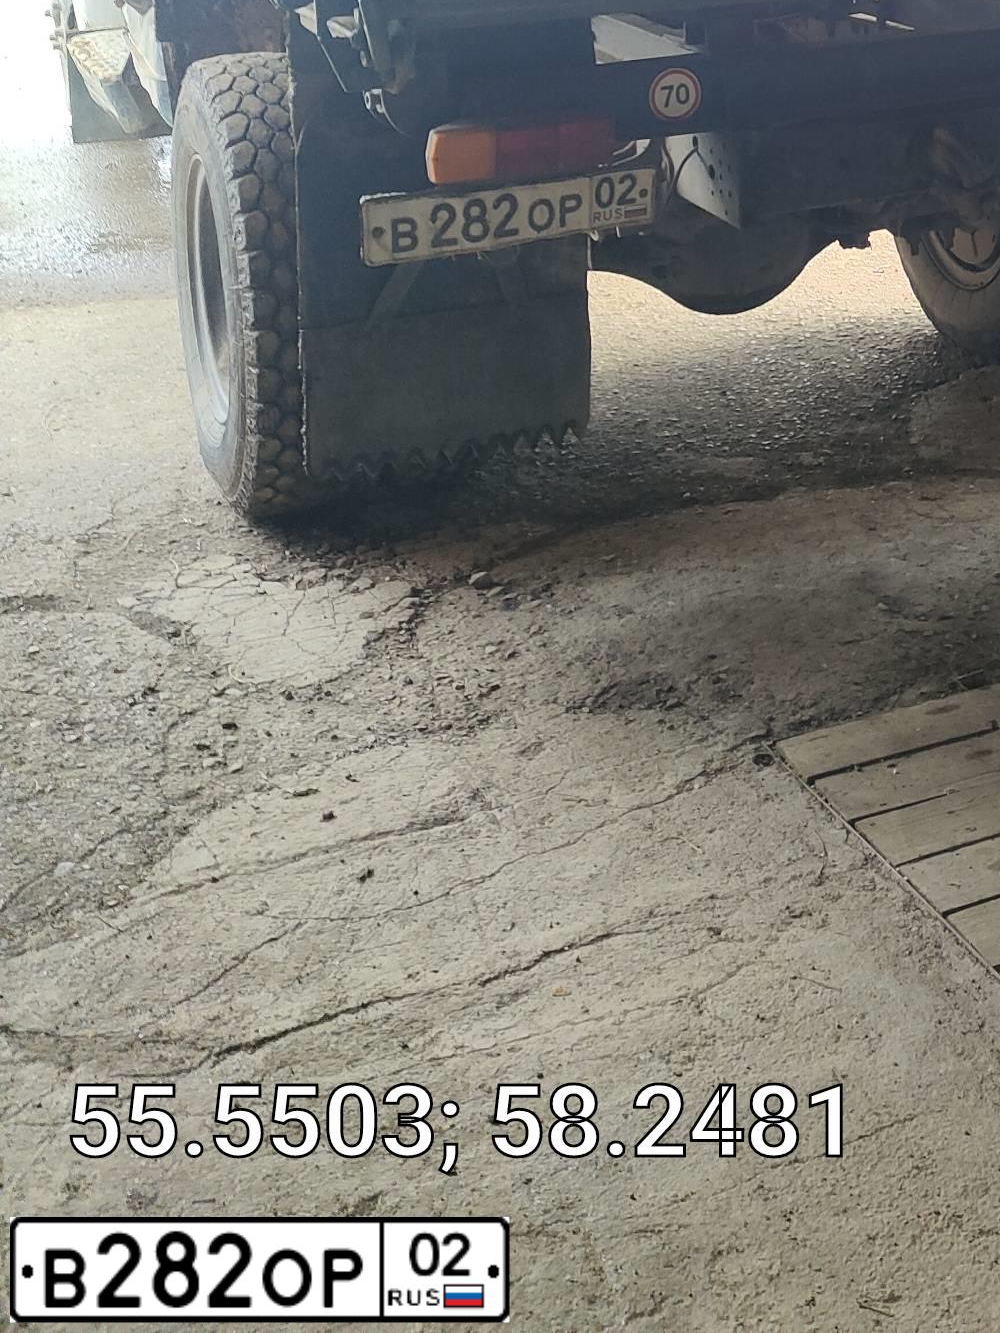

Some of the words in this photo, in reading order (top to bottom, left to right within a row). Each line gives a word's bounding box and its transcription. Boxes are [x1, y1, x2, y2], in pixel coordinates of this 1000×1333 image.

[660, 82, 690, 108] 70
[594, 173, 638, 208] 02
[592, 208, 624, 224] RUS
